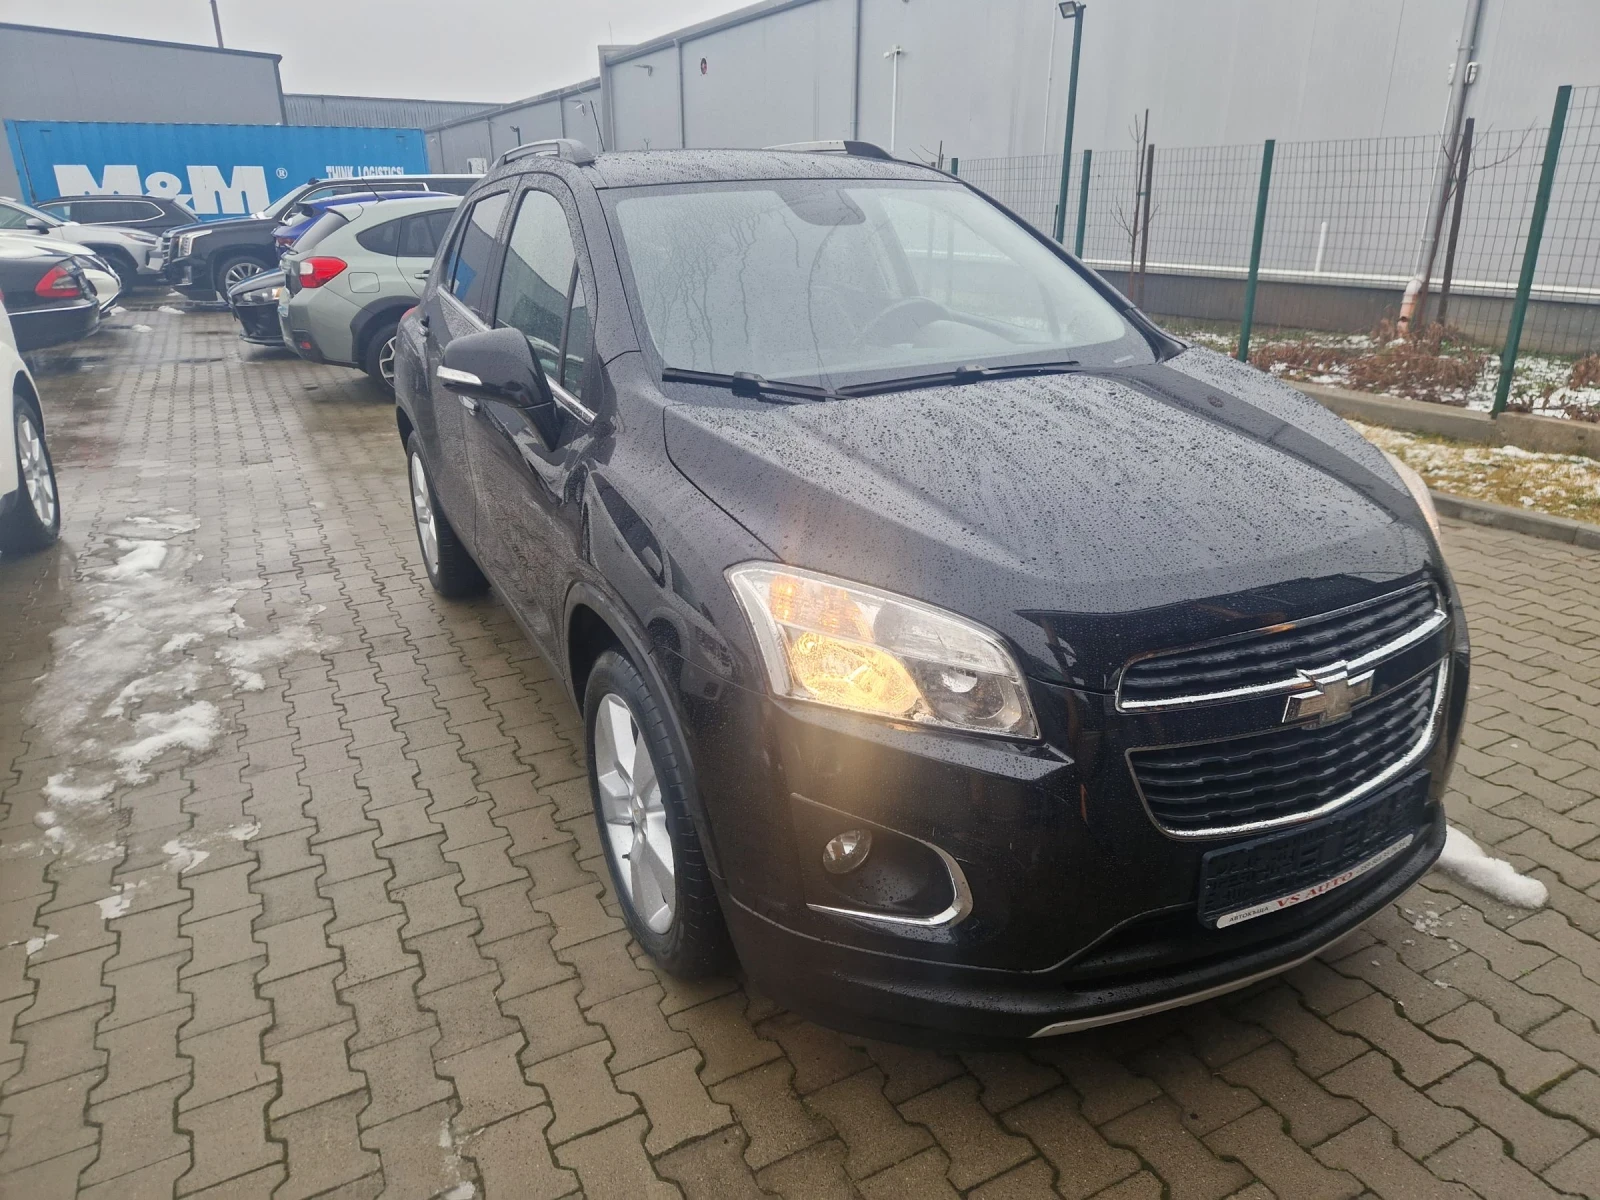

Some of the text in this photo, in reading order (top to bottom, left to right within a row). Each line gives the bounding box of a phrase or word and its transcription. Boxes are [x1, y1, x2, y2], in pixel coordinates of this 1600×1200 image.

[325, 165, 354, 179] THINK
[53, 165, 271, 216] M&M
[1276, 872, 1354, 907] VS AUTO
